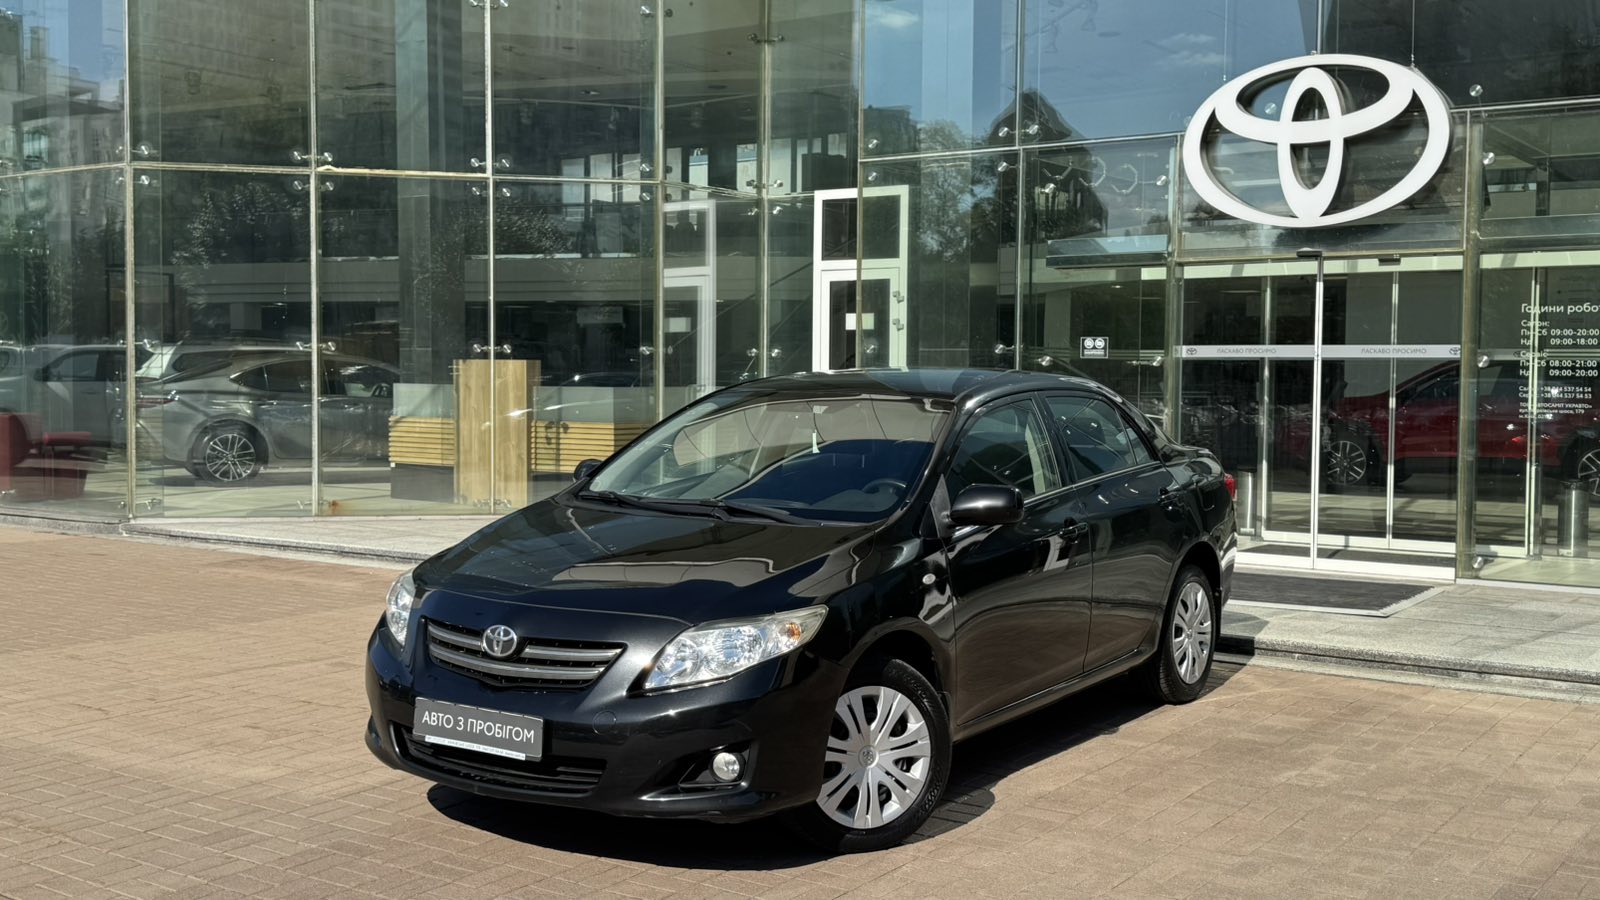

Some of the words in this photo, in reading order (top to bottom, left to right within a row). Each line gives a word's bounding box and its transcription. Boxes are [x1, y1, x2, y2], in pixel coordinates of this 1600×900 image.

[1521, 303, 1564, 314] Години
[1567, 302, 1600, 315] робо
[422, 710, 454, 729] АВТО
[456, 716, 465, 731] З
[467, 719, 535, 743] ПРОБІГОМ
